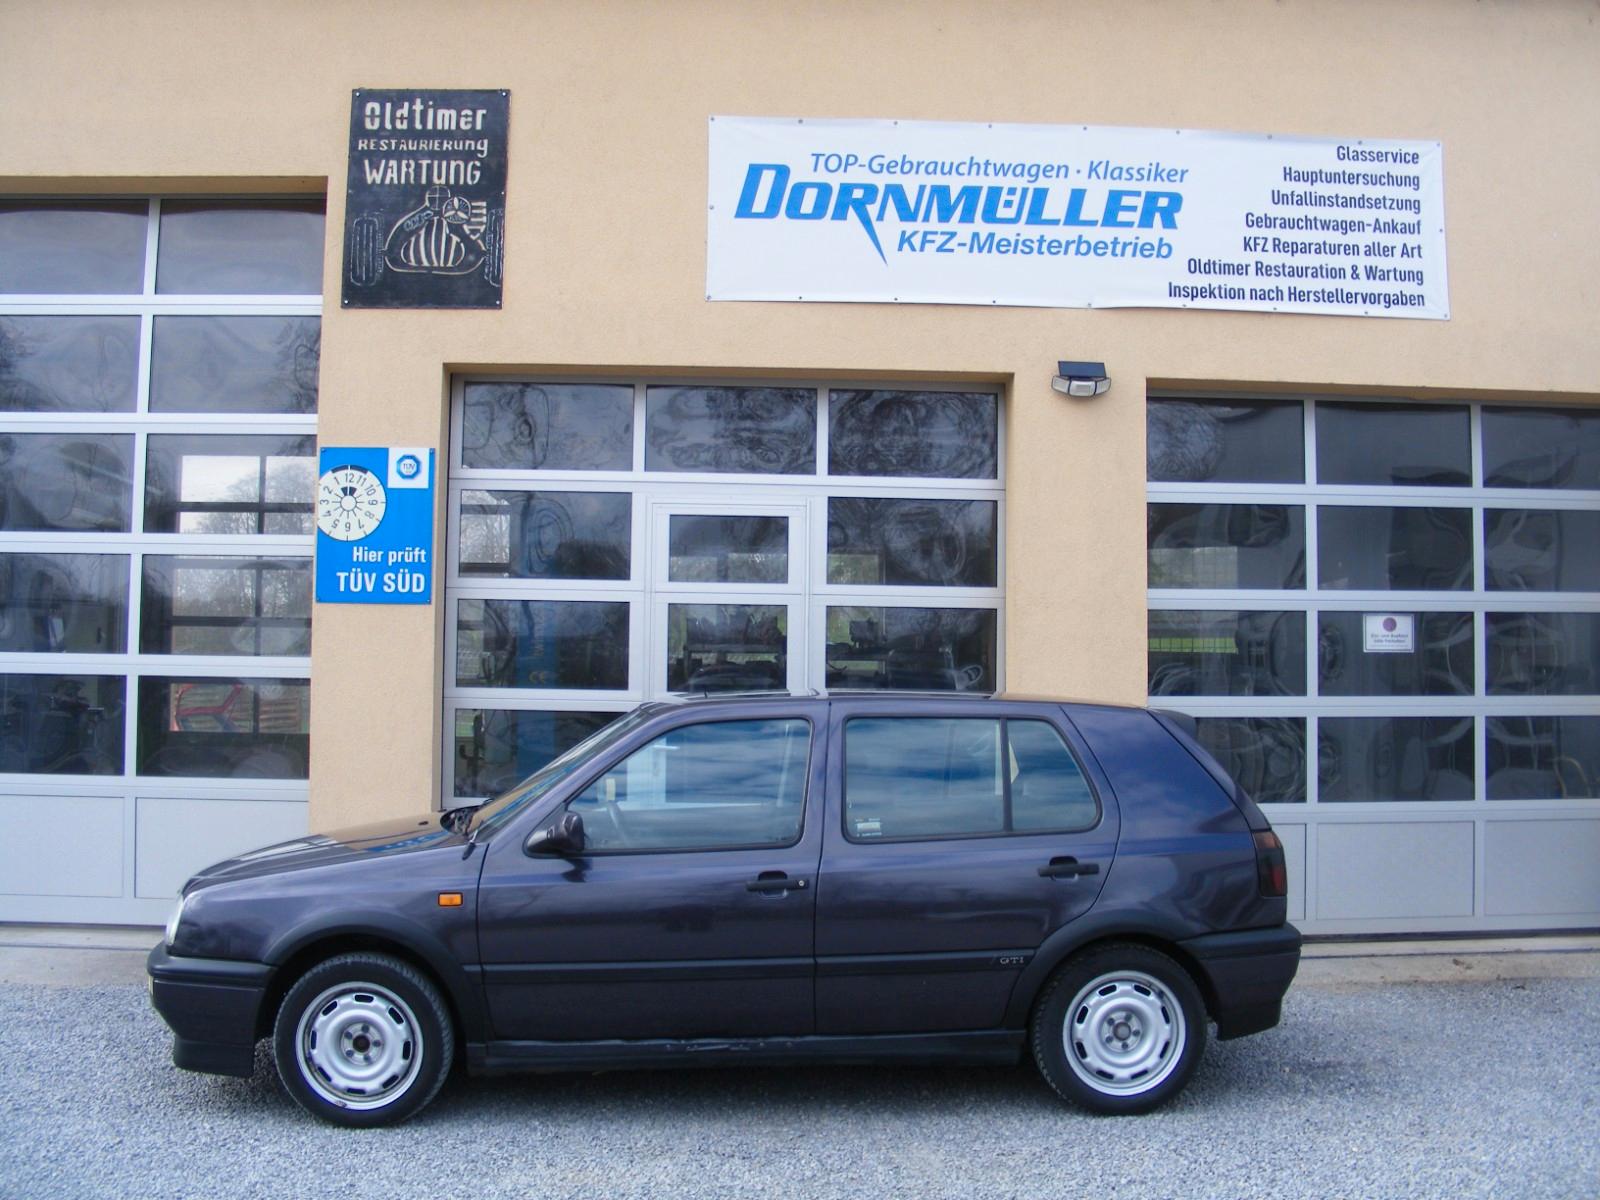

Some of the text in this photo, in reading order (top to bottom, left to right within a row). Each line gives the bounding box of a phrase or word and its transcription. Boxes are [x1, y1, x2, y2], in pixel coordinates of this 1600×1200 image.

[364, 98, 487, 131] Oldtimer
[1337, 146, 1420, 164] Glasservice
[364, 159, 482, 185] WARTUNG
[811, 153, 1189, 183] TOP-Gebrauchtwagen Klassiker
[1283, 167, 1421, 191] Hauptuntersuchung
[1271, 189, 1421, 214] Unfallinstandsetzung
[734, 163, 1184, 266] DORNMÜLLER
[1245, 212, 1422, 236] Gebrauchtwagen-Ankauf
[897, 230, 1173, 259] KFZ-Meisterbetrieb
[1243, 236, 1423, 258] KFZ Reparaturen aller Art
[1187, 258, 1424, 286] Oldtimer Restauration & Wartung
[1168, 281, 1425, 308] Inspektion nach Herstellervorgaben
[345, 472, 355, 483] 12
[352, 546, 427, 566] Hier prüft
[336, 568, 426, 593] TÜV SÜD
[1000, 956, 1025, 965] GTI
